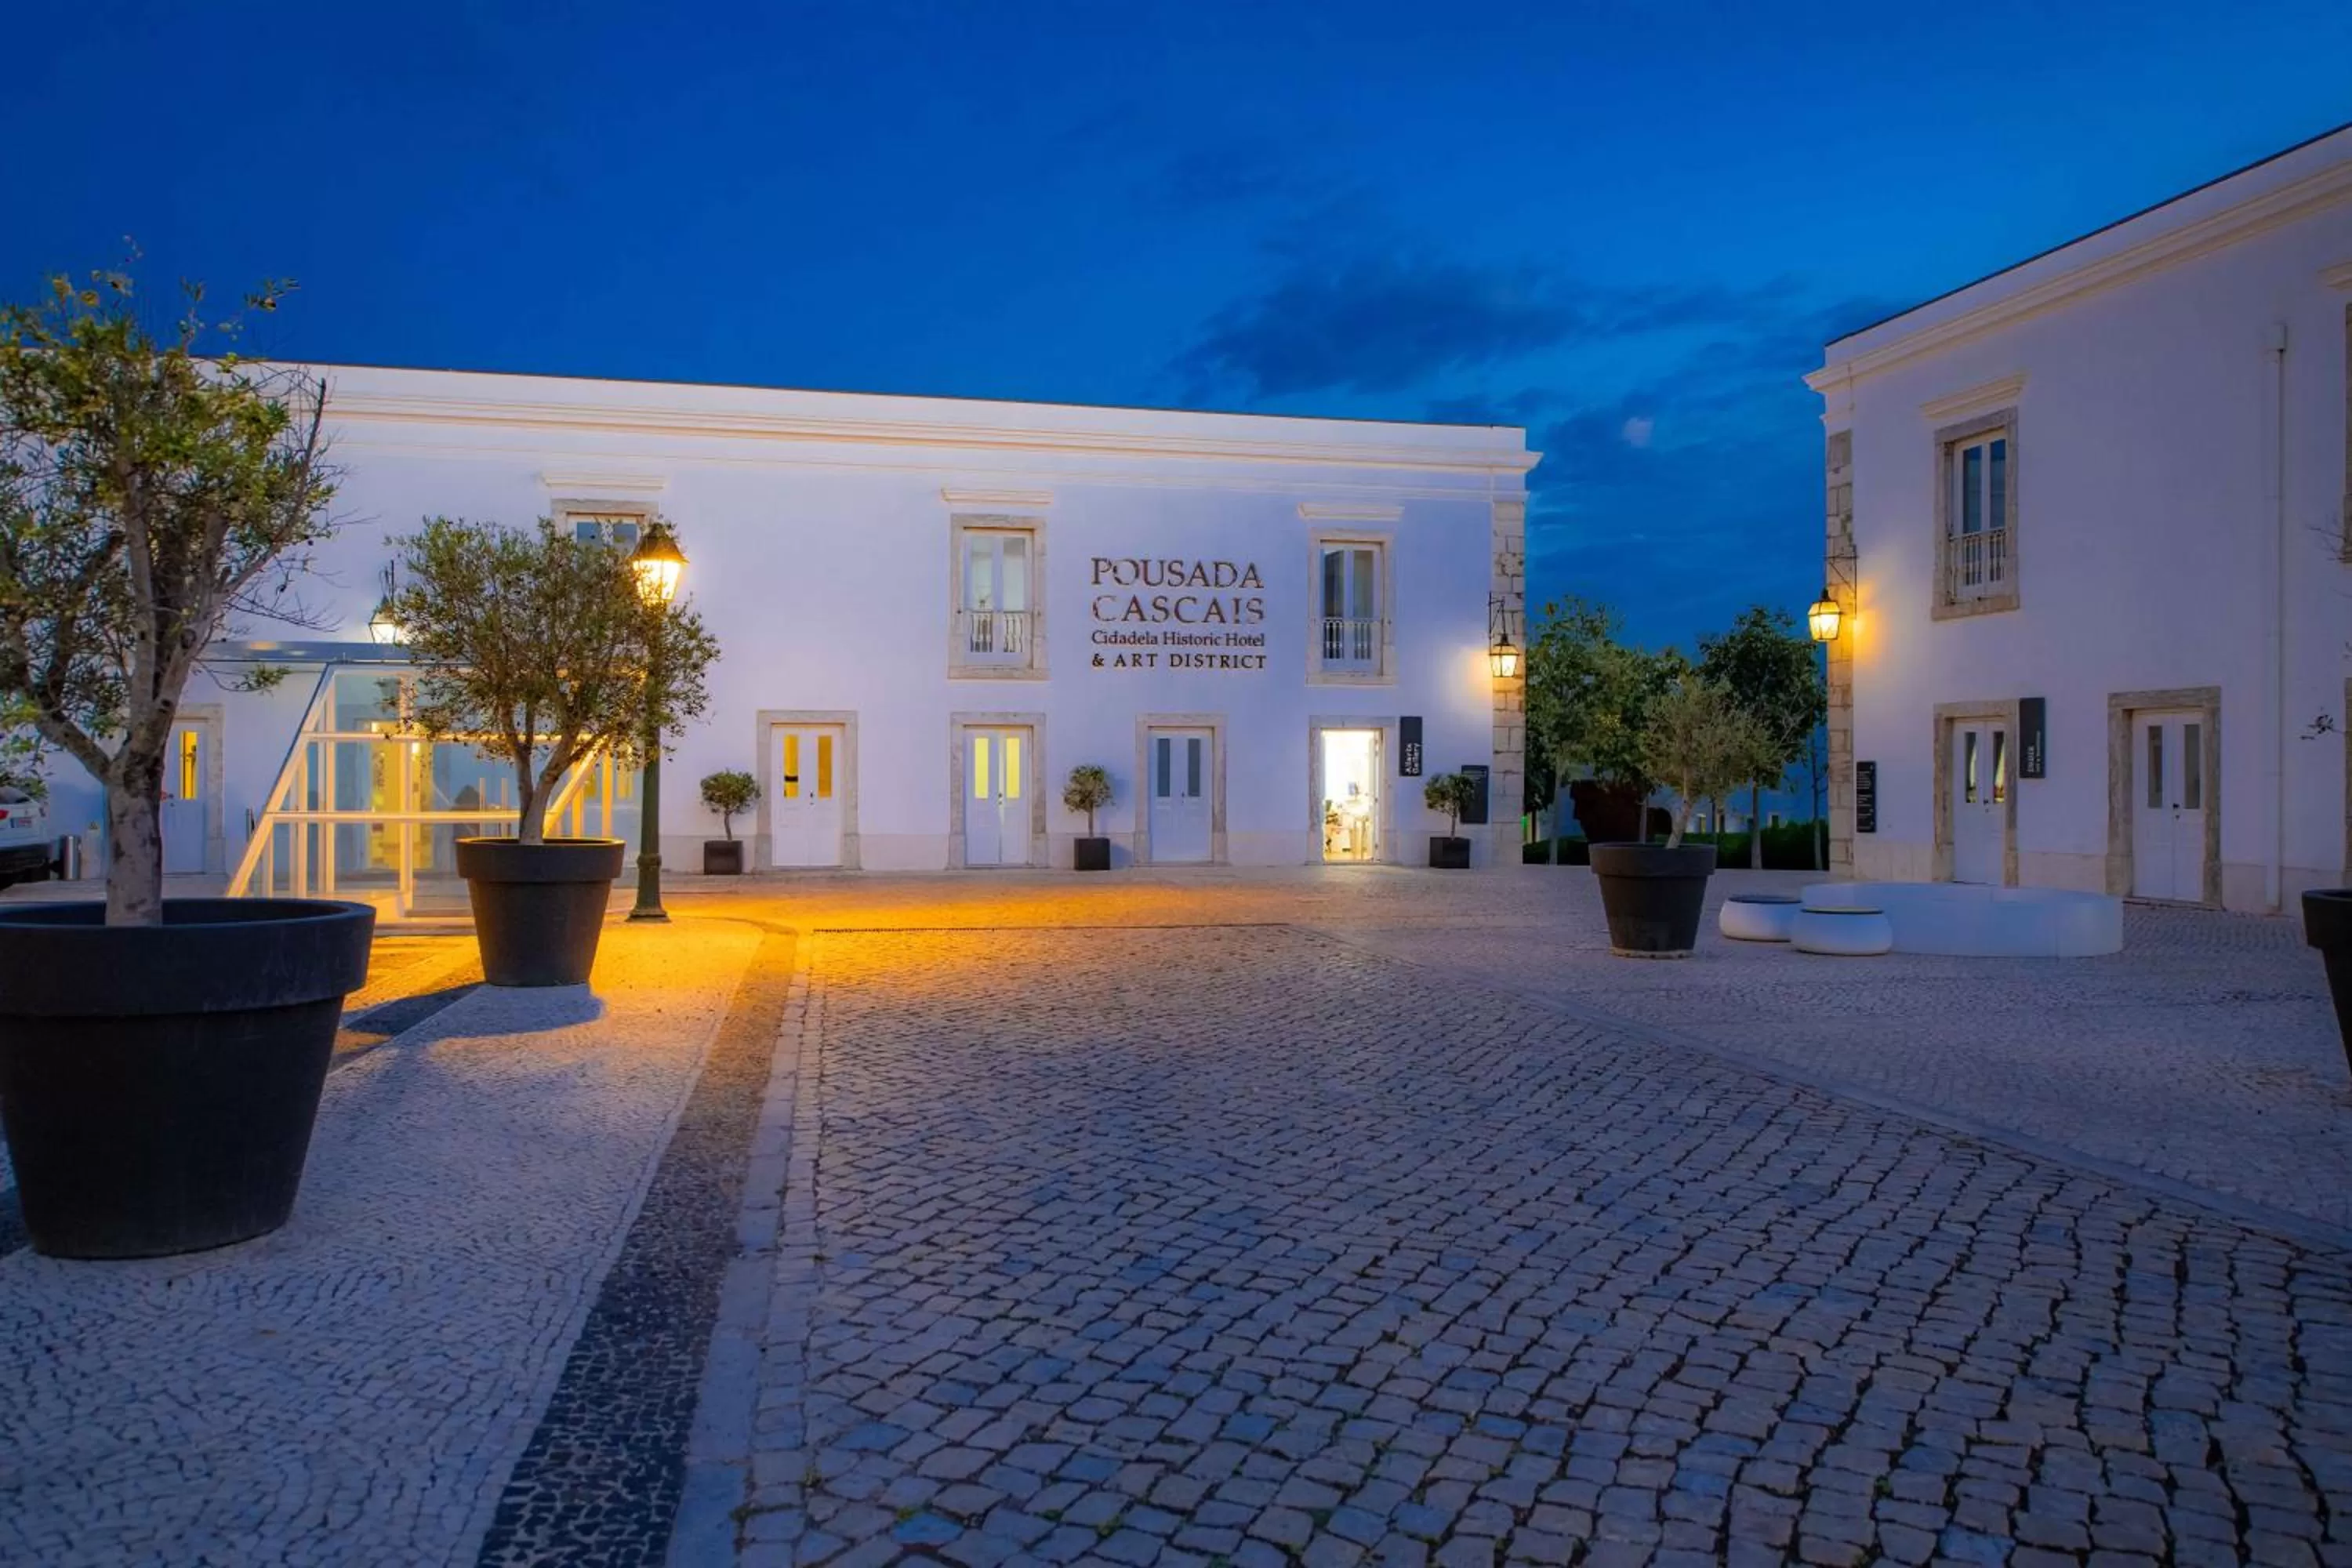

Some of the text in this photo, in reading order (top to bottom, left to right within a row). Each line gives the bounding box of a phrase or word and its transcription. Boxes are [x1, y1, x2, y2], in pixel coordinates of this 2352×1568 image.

[1091, 557, 1264, 588] POUSADA
[1092, 594, 1265, 624] CASCAIS
[1091, 630, 1265, 647] Cidadela Historic Hotel
[1091, 653, 1266, 668] & ART DISTRICT
[1412, 742, 1421, 774] Gallery
